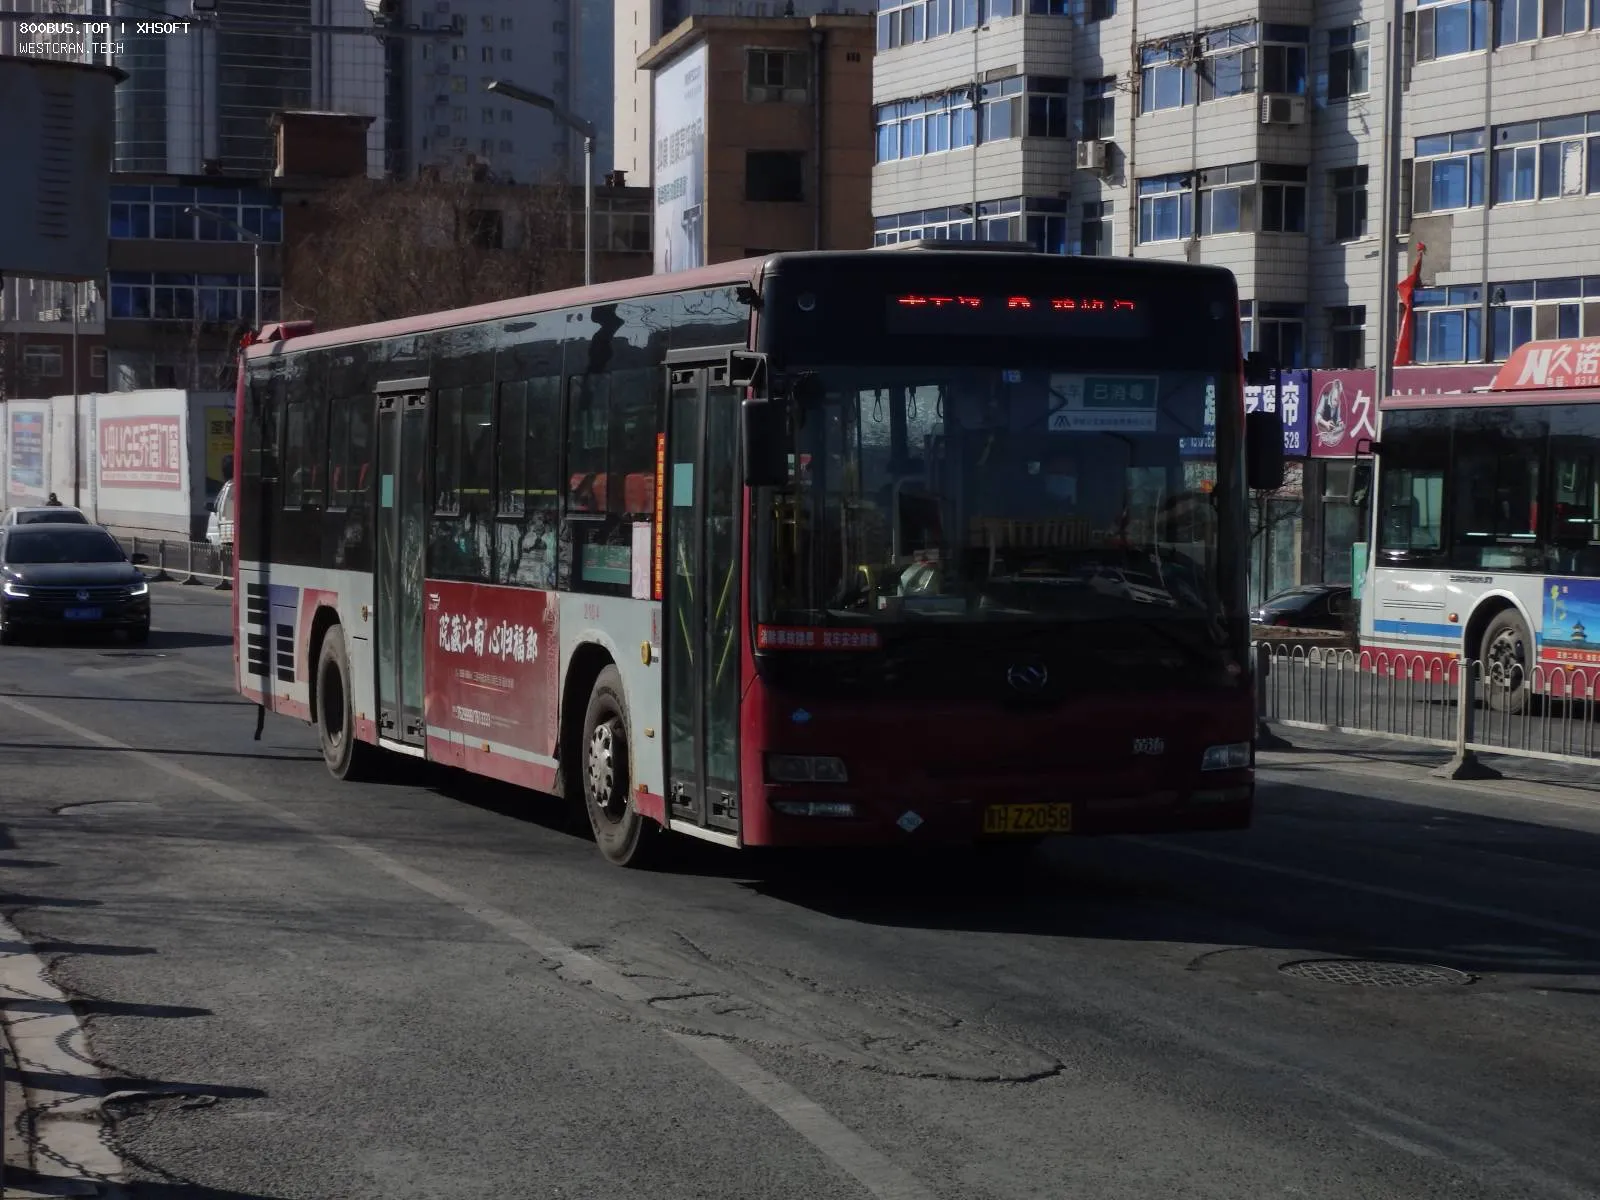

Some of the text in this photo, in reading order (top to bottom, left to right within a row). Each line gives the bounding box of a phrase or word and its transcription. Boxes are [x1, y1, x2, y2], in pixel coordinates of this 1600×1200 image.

[1093, 383, 1145, 401] 已消毒
[1349, 389, 1376, 439] 久
